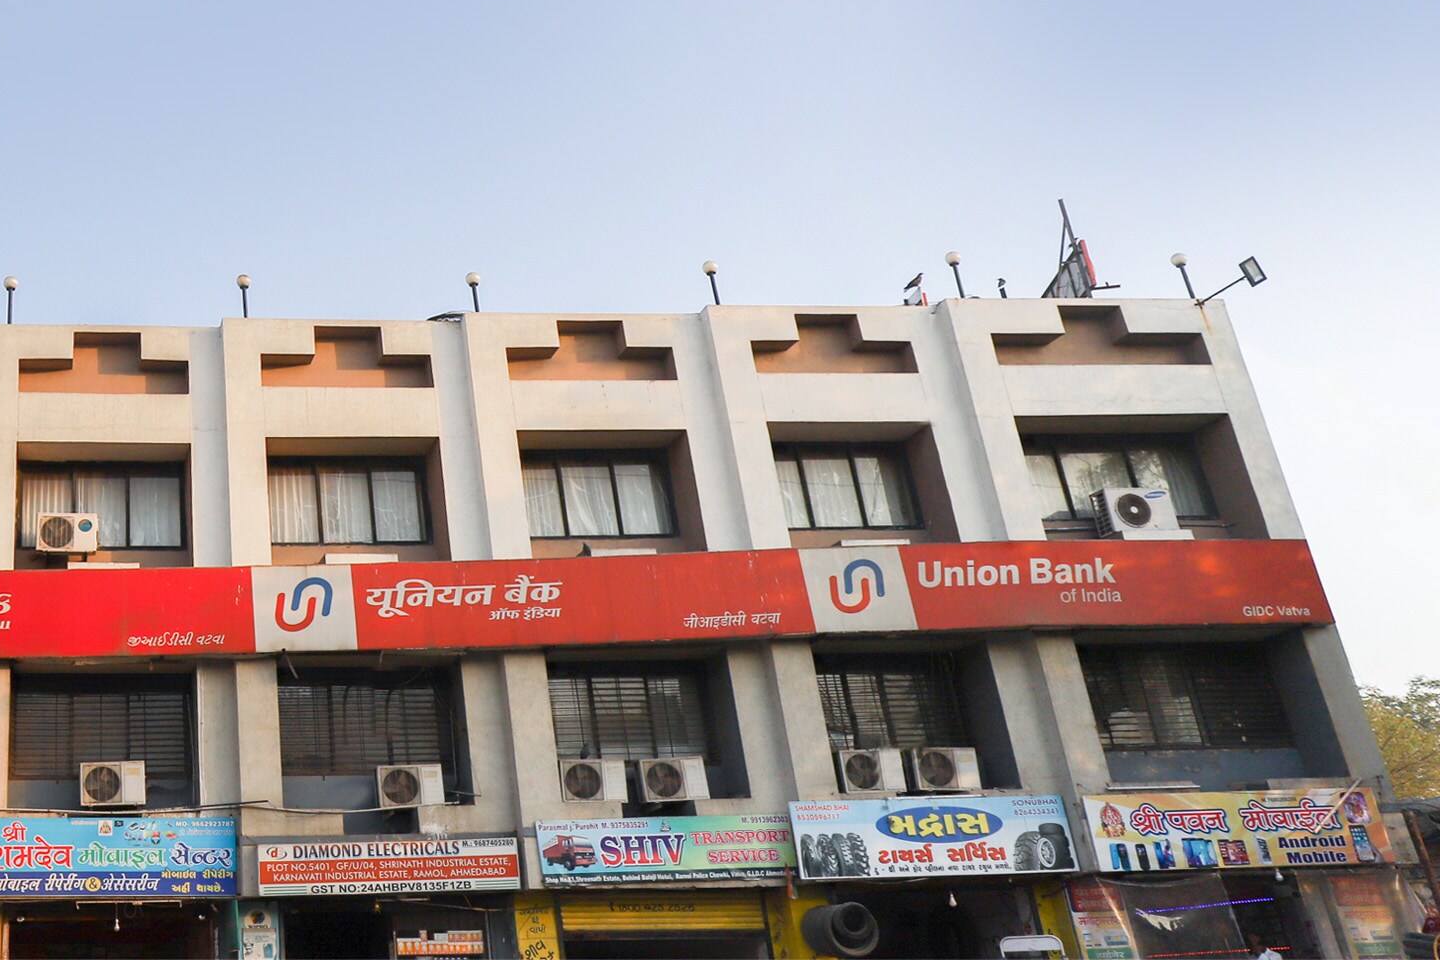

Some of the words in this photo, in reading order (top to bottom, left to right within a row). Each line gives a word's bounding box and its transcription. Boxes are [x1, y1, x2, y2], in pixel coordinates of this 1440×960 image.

[917, 559, 1020, 587] Union
[1029, 557, 1116, 585] Bank
[365, 578, 496, 616] यूनियन
[505, 574, 563, 604] बैंक
[1060, 589, 1076, 603] of
[1081, 588, 1122, 603] India
[489, 607, 519, 622] ऑफ
[522, 605, 562, 620] इंडिया
[1242, 605, 1274, 617] GIDC
[1277, 606, 1311, 617] Vatva
[196, 634, 226, 645] વટવા
[1011, 798, 1058, 806] SONUBHAI
[538, 823, 569, 831] Parasmal
[575, 822, 599, 831] Purohit
[1132, 804, 1163, 835] श्री
[1165, 809, 1228, 833] पवन
[2, 821, 27, 842] श्री
[690, 829, 789, 845] TRANSPORT
[1279, 835, 1347, 848] Android
[77, 842, 167, 868] मोबाइल
[169, 842, 234, 868] सेन्टर
[293, 843, 362, 859] DIAMOND
[367, 841, 460, 857] ELECTRICALS
[601, 833, 685, 866] SHIV
[708, 849, 780, 864] SERVICE
[267, 863, 288, 872] PLOT
[290, 862, 334, 872] NO.5401,
[336, 860, 378, 871] GF/U/04,
[379, 859, 423, 869] SHRINATH
[425, 858, 478, 868] INDUSTRIAL
[479, 857, 512, 867] ESTATE,
[1287, 851, 1347, 864] Mobile
[273, 872, 323, 882] KARNAVATI
[324, 870, 377, 881] INDUSTRIAL
[379, 869, 411, 880] ESTATE,
[413, 868, 448, 878] RAMOL,
[450, 866, 506, 877] AHMEDABAD
[88, 880, 98, 890] &
[311, 884, 335, 894] GST
[339, 881, 472, 893] NO:24AHBPV8135F1ZB
